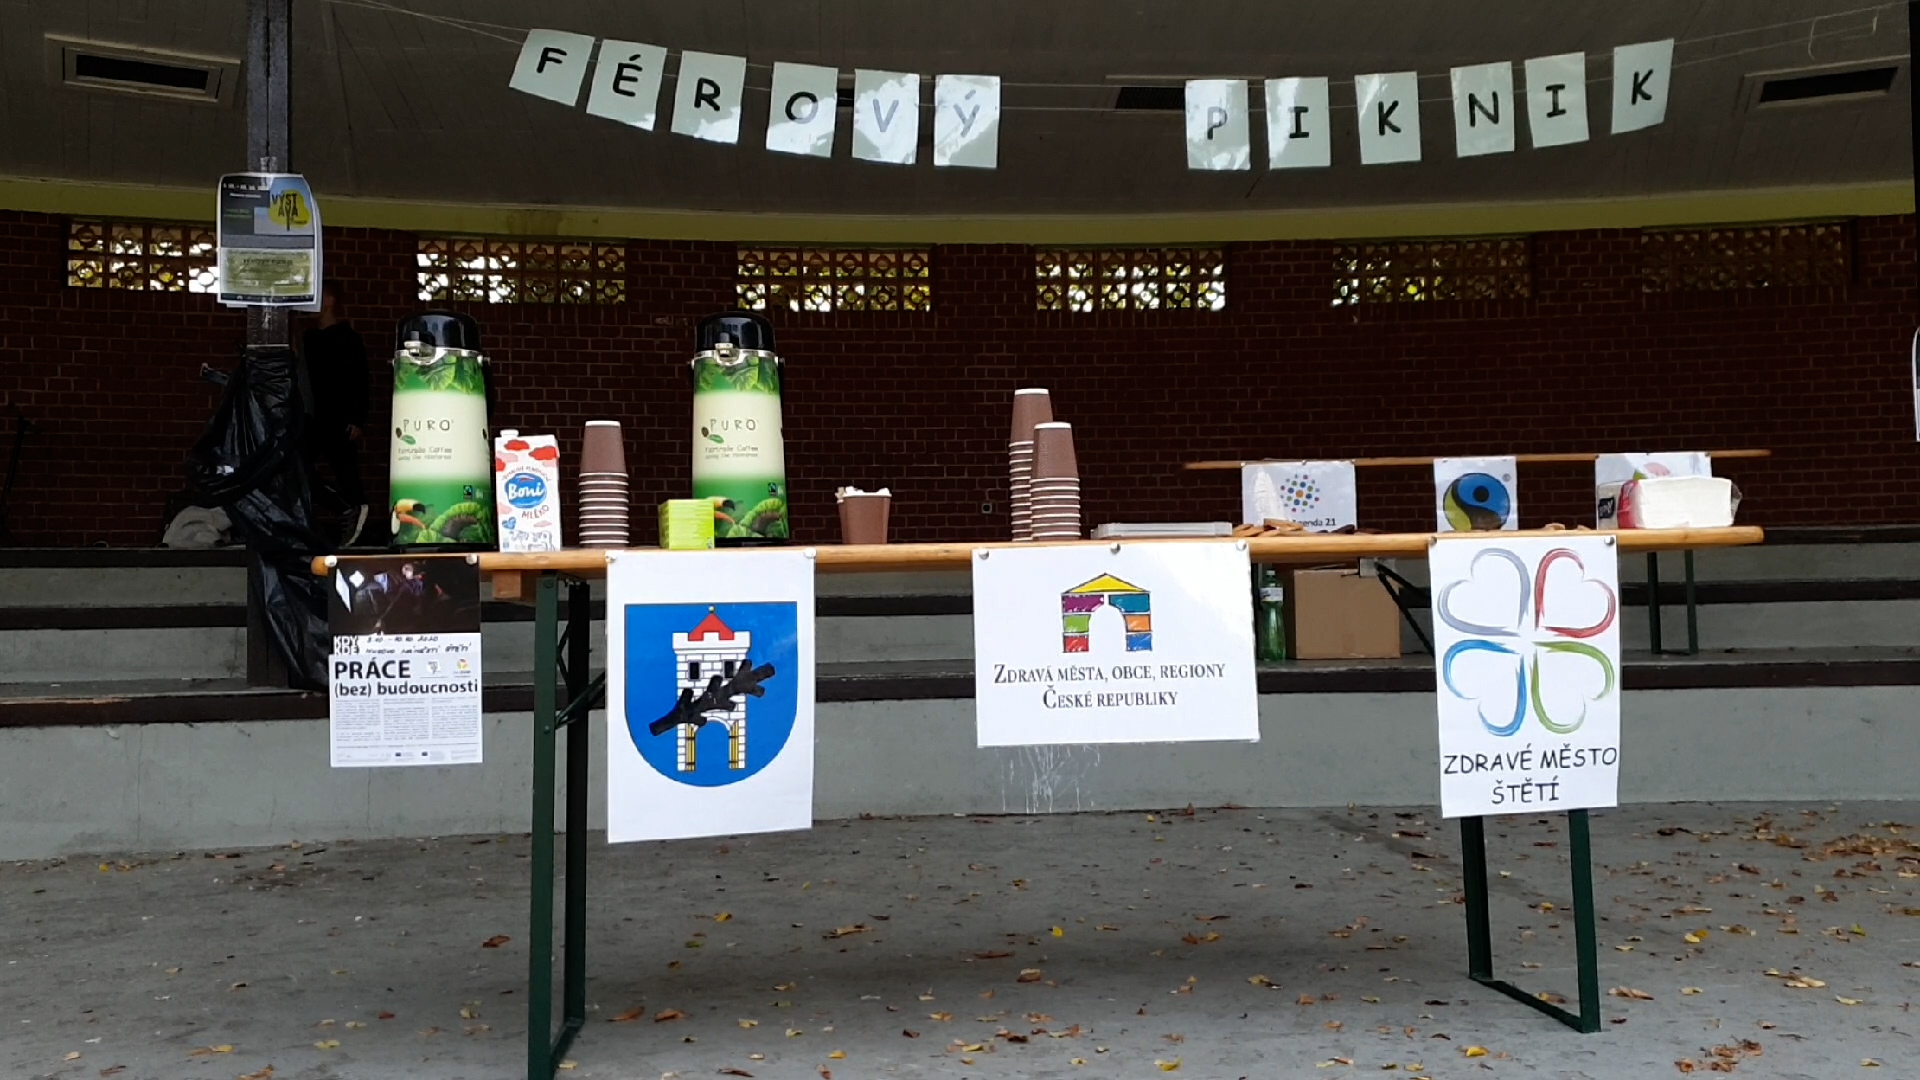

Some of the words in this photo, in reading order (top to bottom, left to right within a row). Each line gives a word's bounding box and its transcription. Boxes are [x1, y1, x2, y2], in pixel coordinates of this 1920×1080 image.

[536, 47, 980, 138] FÉROVÝ
[1206, 68, 1653, 141] PIKNIK
[403, 419, 451, 432] PURO
[710, 418, 757, 431] PURO
[508, 482, 545, 500] Boni
[1325, 518, 1336, 527] 21
[335, 658, 411, 680] PRÁCE
[1112, 666, 1156, 682] OBCE,
[1160, 663, 1225, 679] REGIONY
[335, 682, 372, 698] (bez)
[377, 679, 478, 696] budoucnosti
[1097, 691, 1179, 708] REPUBLIKY
[1443, 743, 1533, 775] ZDRAVÉ
[1540, 742, 1617, 769] MĚSTO
[1491, 775, 1560, 804] ŠTĚTÍ
